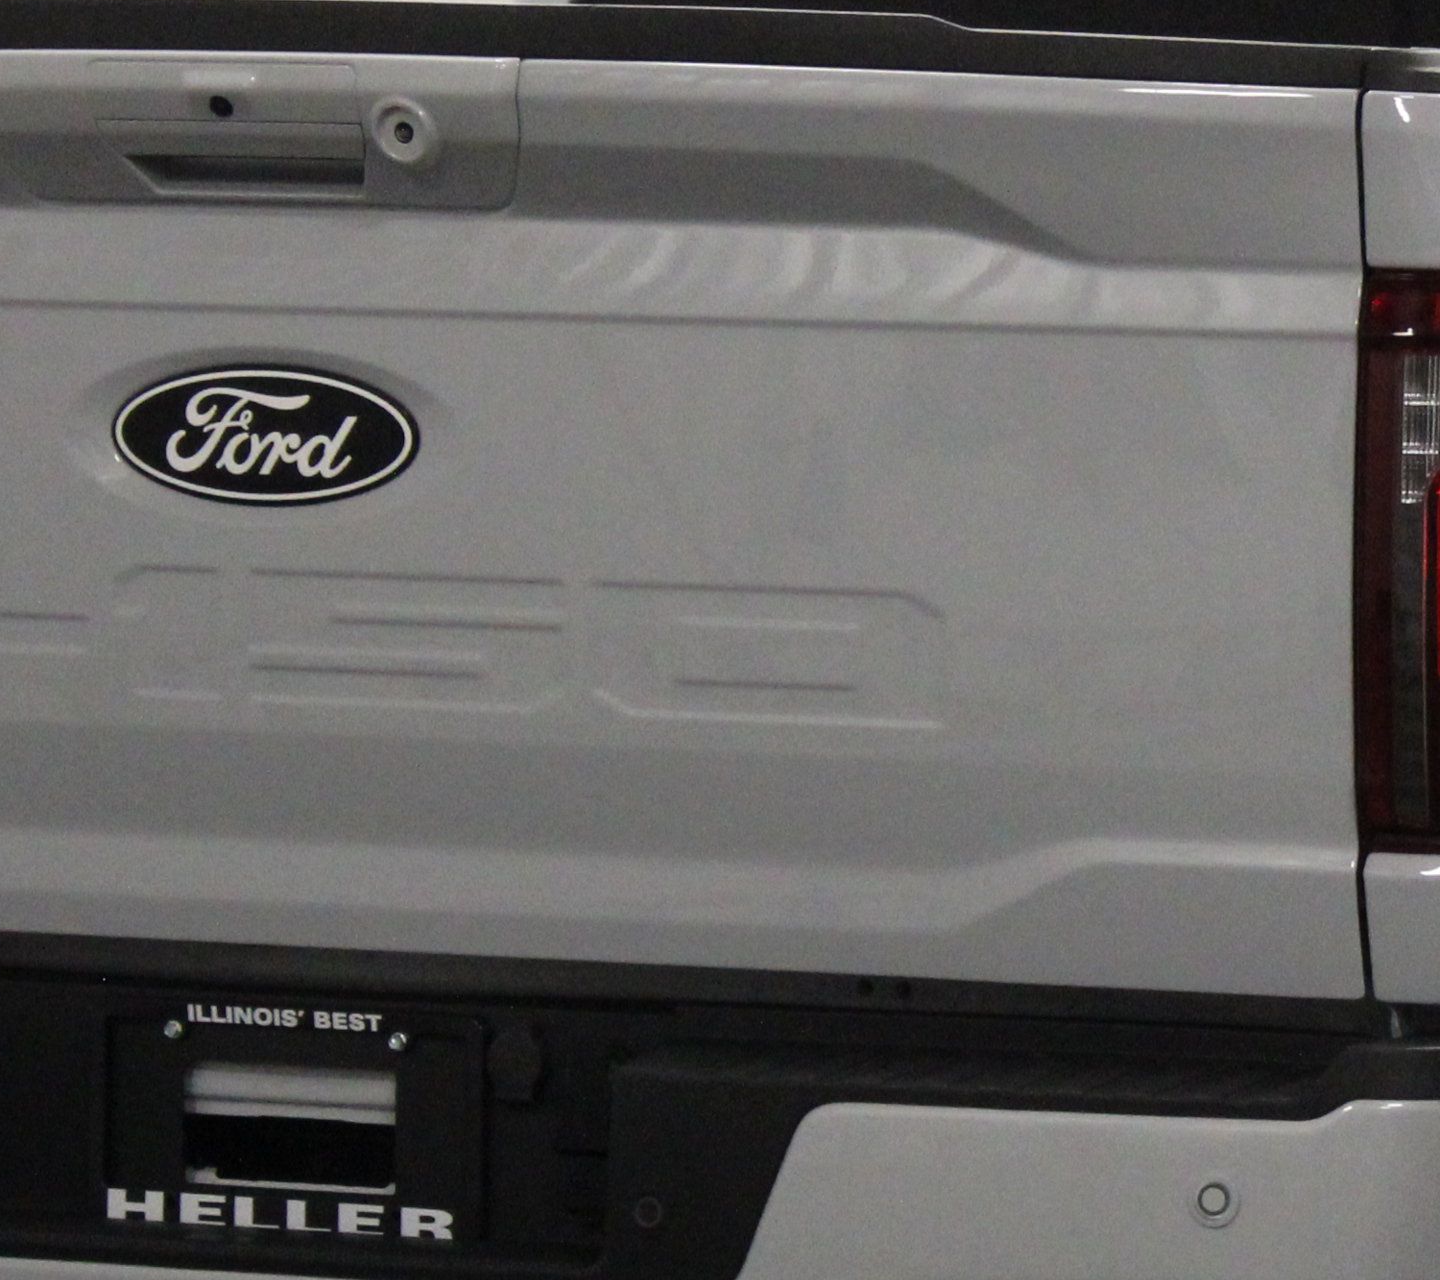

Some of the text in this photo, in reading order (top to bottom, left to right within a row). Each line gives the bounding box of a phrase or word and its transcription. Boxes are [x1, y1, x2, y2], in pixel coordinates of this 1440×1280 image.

[165, 386, 358, 480] Ford
[313, 1011, 383, 1032] BEST
[105, 1186, 454, 1240] HELLER
